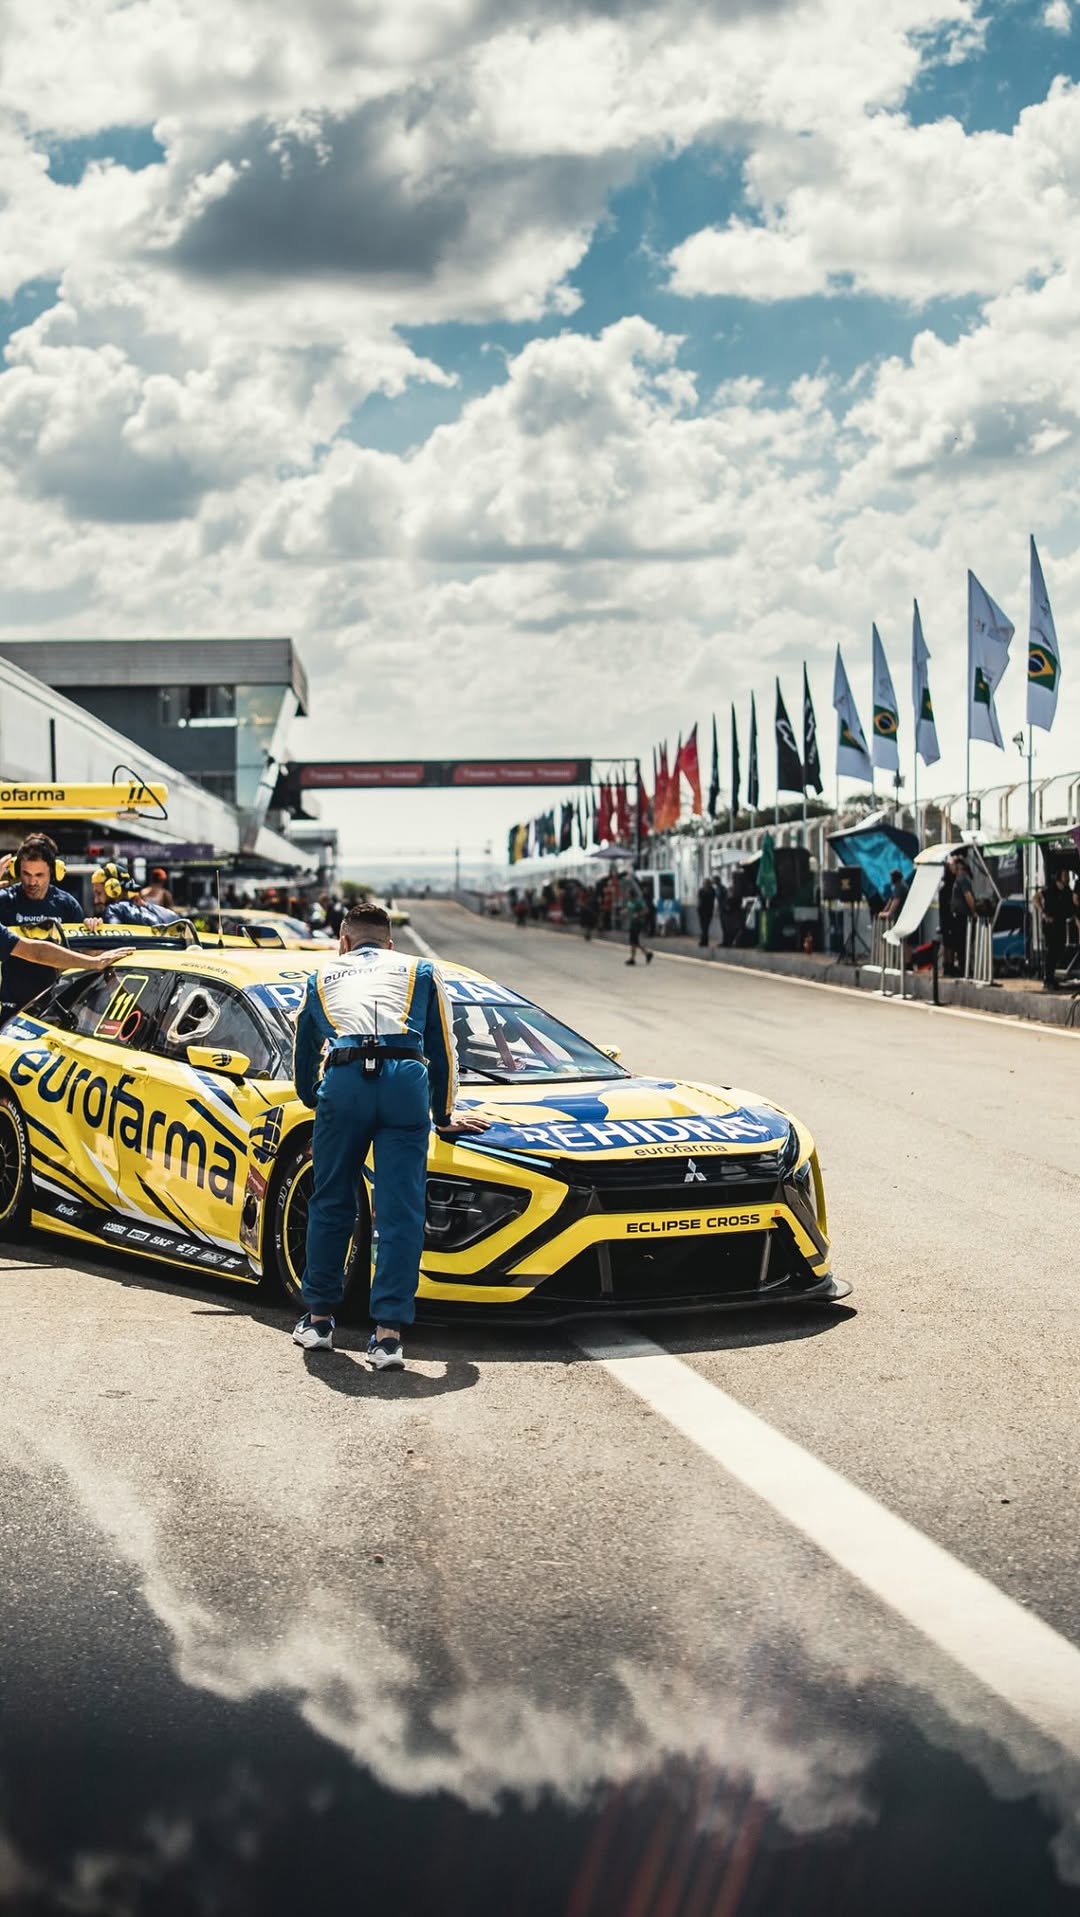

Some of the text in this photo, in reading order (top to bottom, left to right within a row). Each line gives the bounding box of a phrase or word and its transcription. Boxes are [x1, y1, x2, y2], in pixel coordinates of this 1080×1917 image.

[109, 992, 135, 1021] 11
[9, 1049, 237, 1206] eurofarma
[634, 1142, 728, 1156] eurofarma
[626, 1220, 701, 1233] ECLIPSE
[706, 1213, 760, 1229] CROSS
[149, 1236, 174, 1247] SKF
